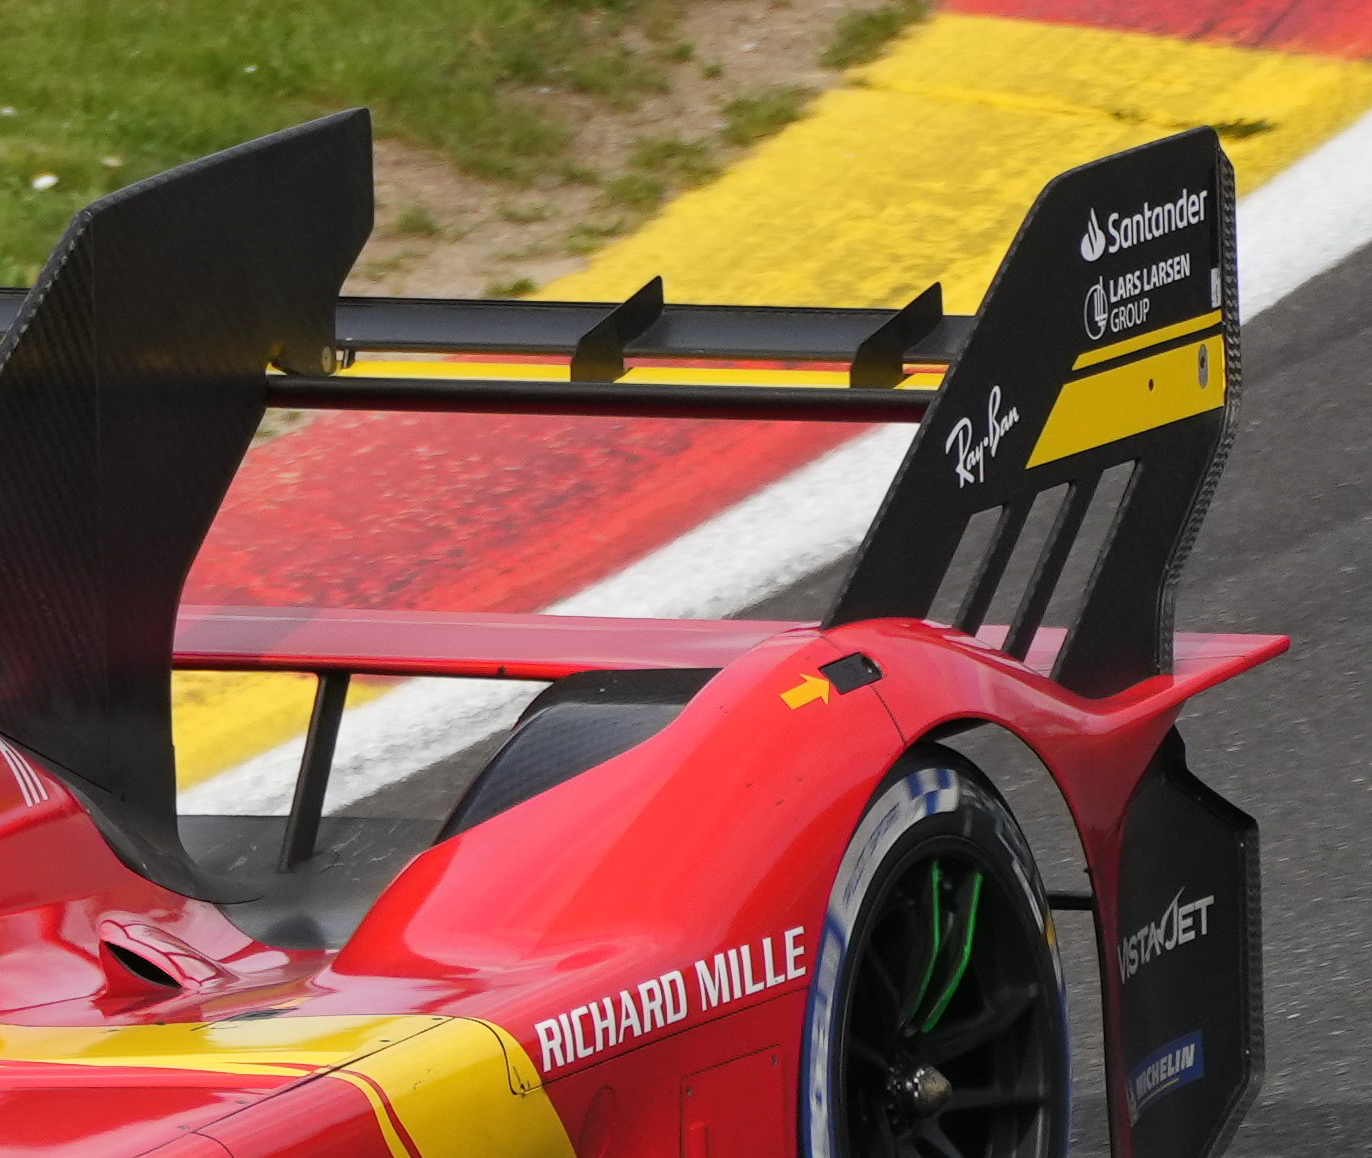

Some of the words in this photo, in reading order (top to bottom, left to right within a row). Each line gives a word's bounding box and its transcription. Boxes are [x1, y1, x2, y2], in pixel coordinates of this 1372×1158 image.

[1108, 188, 1208, 253] Santander
[1109, 270, 1143, 303] LARS
[1143, 252, 1191, 292] LARSEN
[1110, 297, 1150, 332] GROUP
[534, 969, 688, 1073] RICHARD
[694, 925, 807, 1012] MILLE
[1136, 1043, 1197, 1094] MICHELIN
